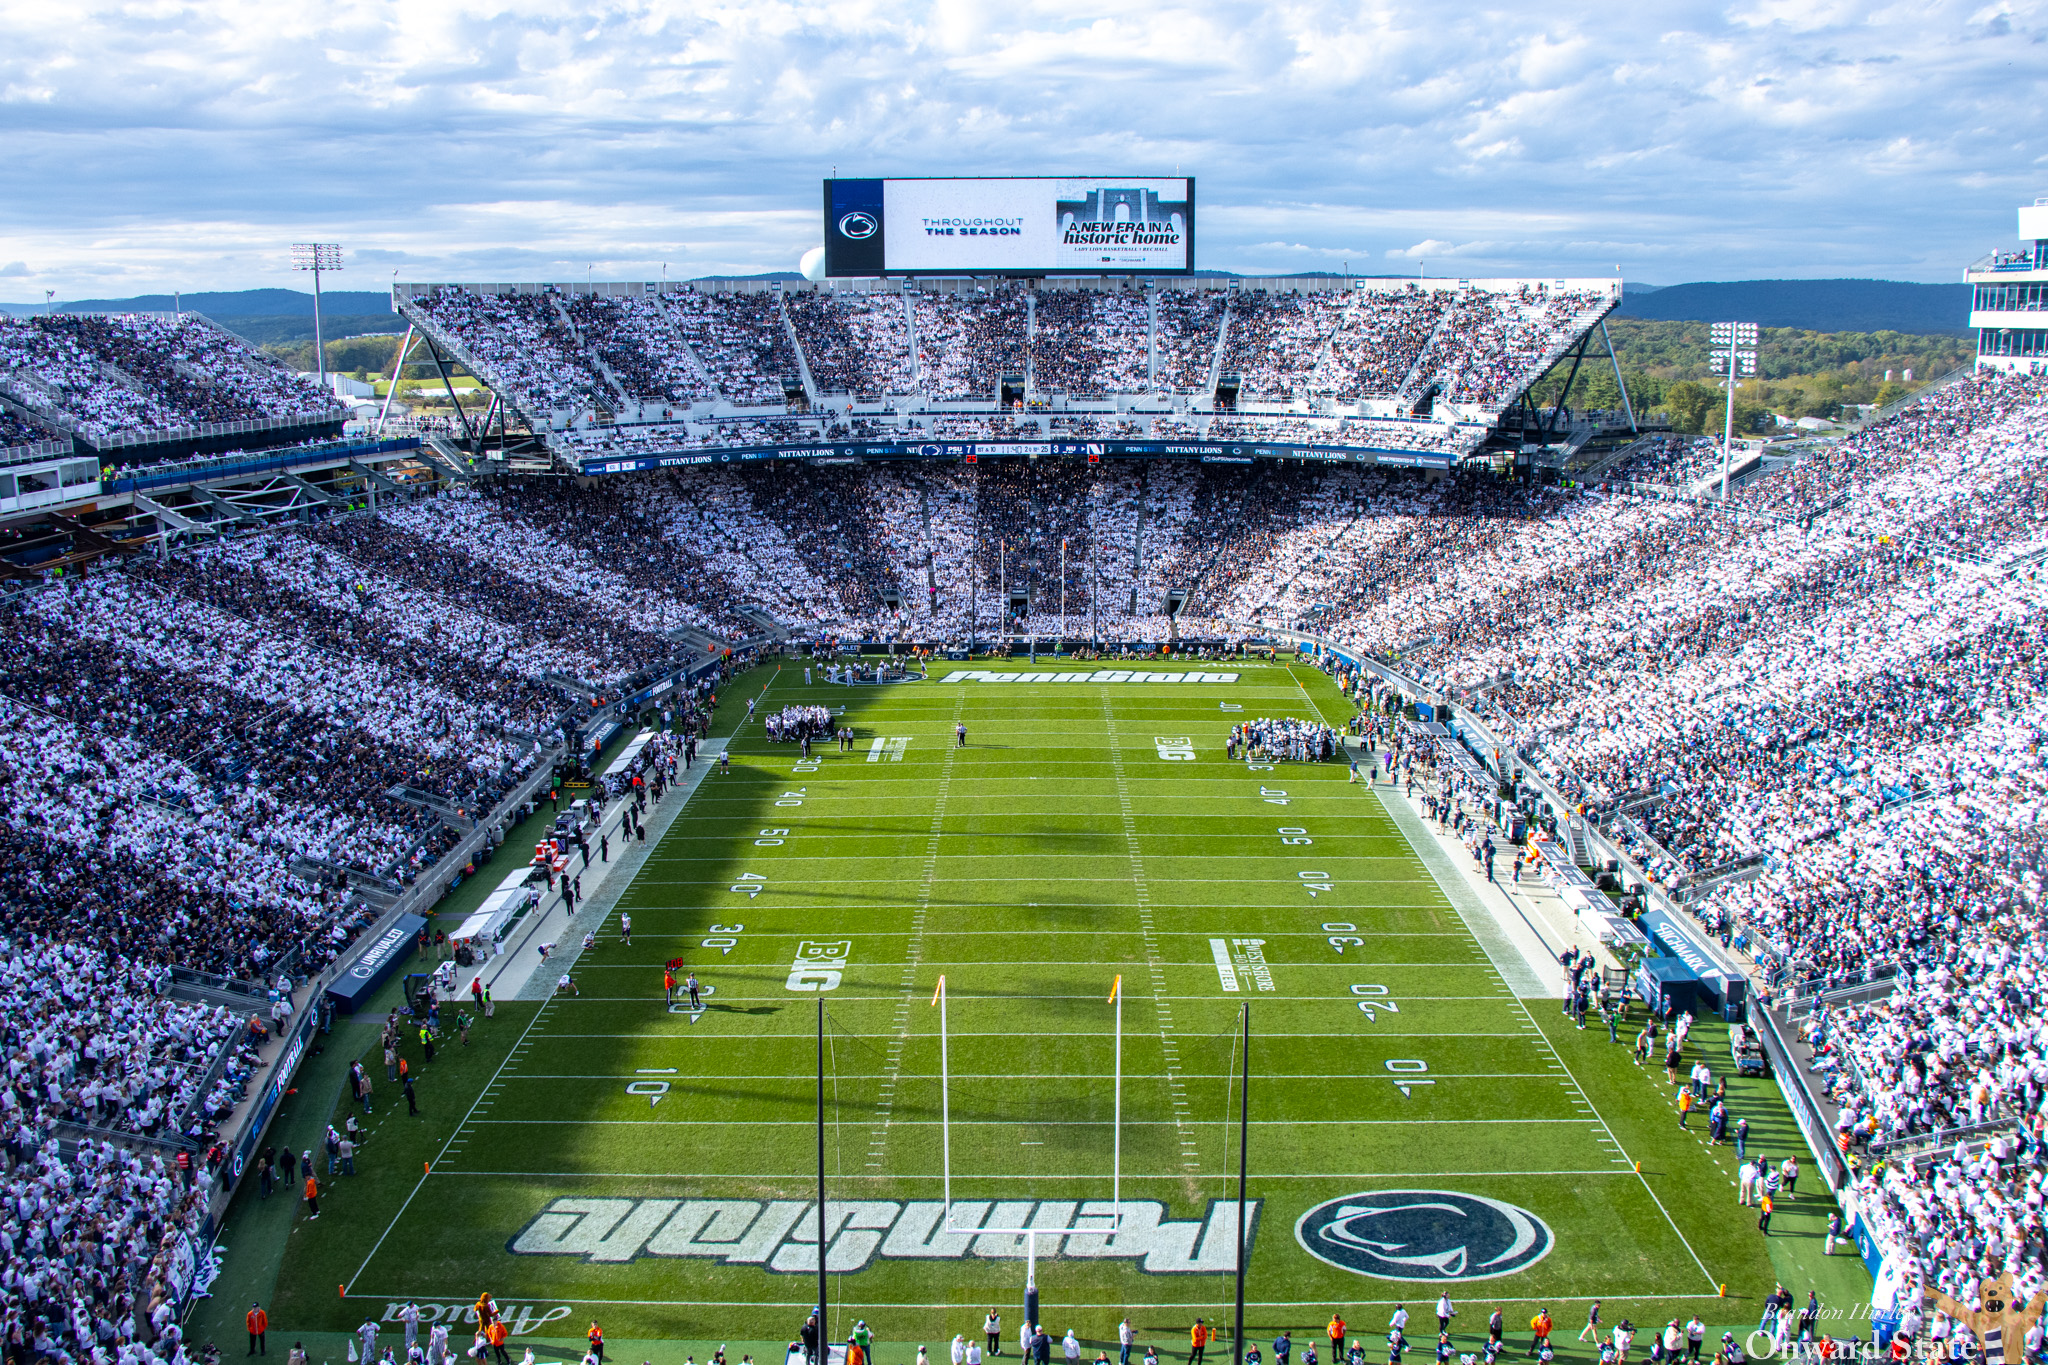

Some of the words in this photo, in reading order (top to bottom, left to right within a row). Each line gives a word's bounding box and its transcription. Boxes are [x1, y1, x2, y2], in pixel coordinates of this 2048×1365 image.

[922, 218, 1024, 226] THROUGHOUT
[925, 227, 954, 235] THE
[959, 227, 1020, 235] SEASON
[1069, 221, 1078, 231] A
[1081, 221, 1114, 232] NEW
[1116, 221, 1145, 232] ERA
[1149, 221, 1161, 232] IN
[1164, 222, 1174, 232] A
[1063, 230, 1129, 244] historic
[1132, 230, 1180, 244] home
[778, 450, 811, 458] NITTANY
[966, 445, 972, 453] 7
[1053, 445, 1059, 453] 3
[1199, 446, 1222, 454] LIONS
[1292, 450, 1323, 458] NITTANY
[1324, 451, 1346, 460] LIONS
[659, 458, 690, 467] NITTANY
[691, 456, 712, 464] LIONS
[966, 455, 977, 463] 25
[1089, 455, 1099, 463] 25
[652, 678, 674, 697] FOOTBALL
[791, 758, 822, 773] 30
[1245, 757, 1275, 771] 30
[774, 790, 807, 807] 40
[1259, 789, 1291, 805] 40
[753, 828, 791, 846] 50
[1277, 827, 1313, 845] 50
[729, 872, 768, 893] 40
[1298, 871, 1335, 891] 40
[701, 923, 745, 947] 30
[1321, 922, 1365, 947] 30
[360, 928, 405, 966] UNRIVALED
[1245, 944, 1267, 964] WEST
[1654, 921, 1709, 973] HIGHMARK
[1221, 969, 1236, 990] FIELD
[1251, 966, 1276, 992] SHORE
[668, 985, 716, 1014] 20
[1350, 984, 1400, 1013] 20
[276, 1035, 304, 1093] FOOTBALL
[1384, 1059, 1437, 1086] 10
[625, 1067, 679, 1095] 10
[1784, 1069, 1813, 1136] FOOTBALL
